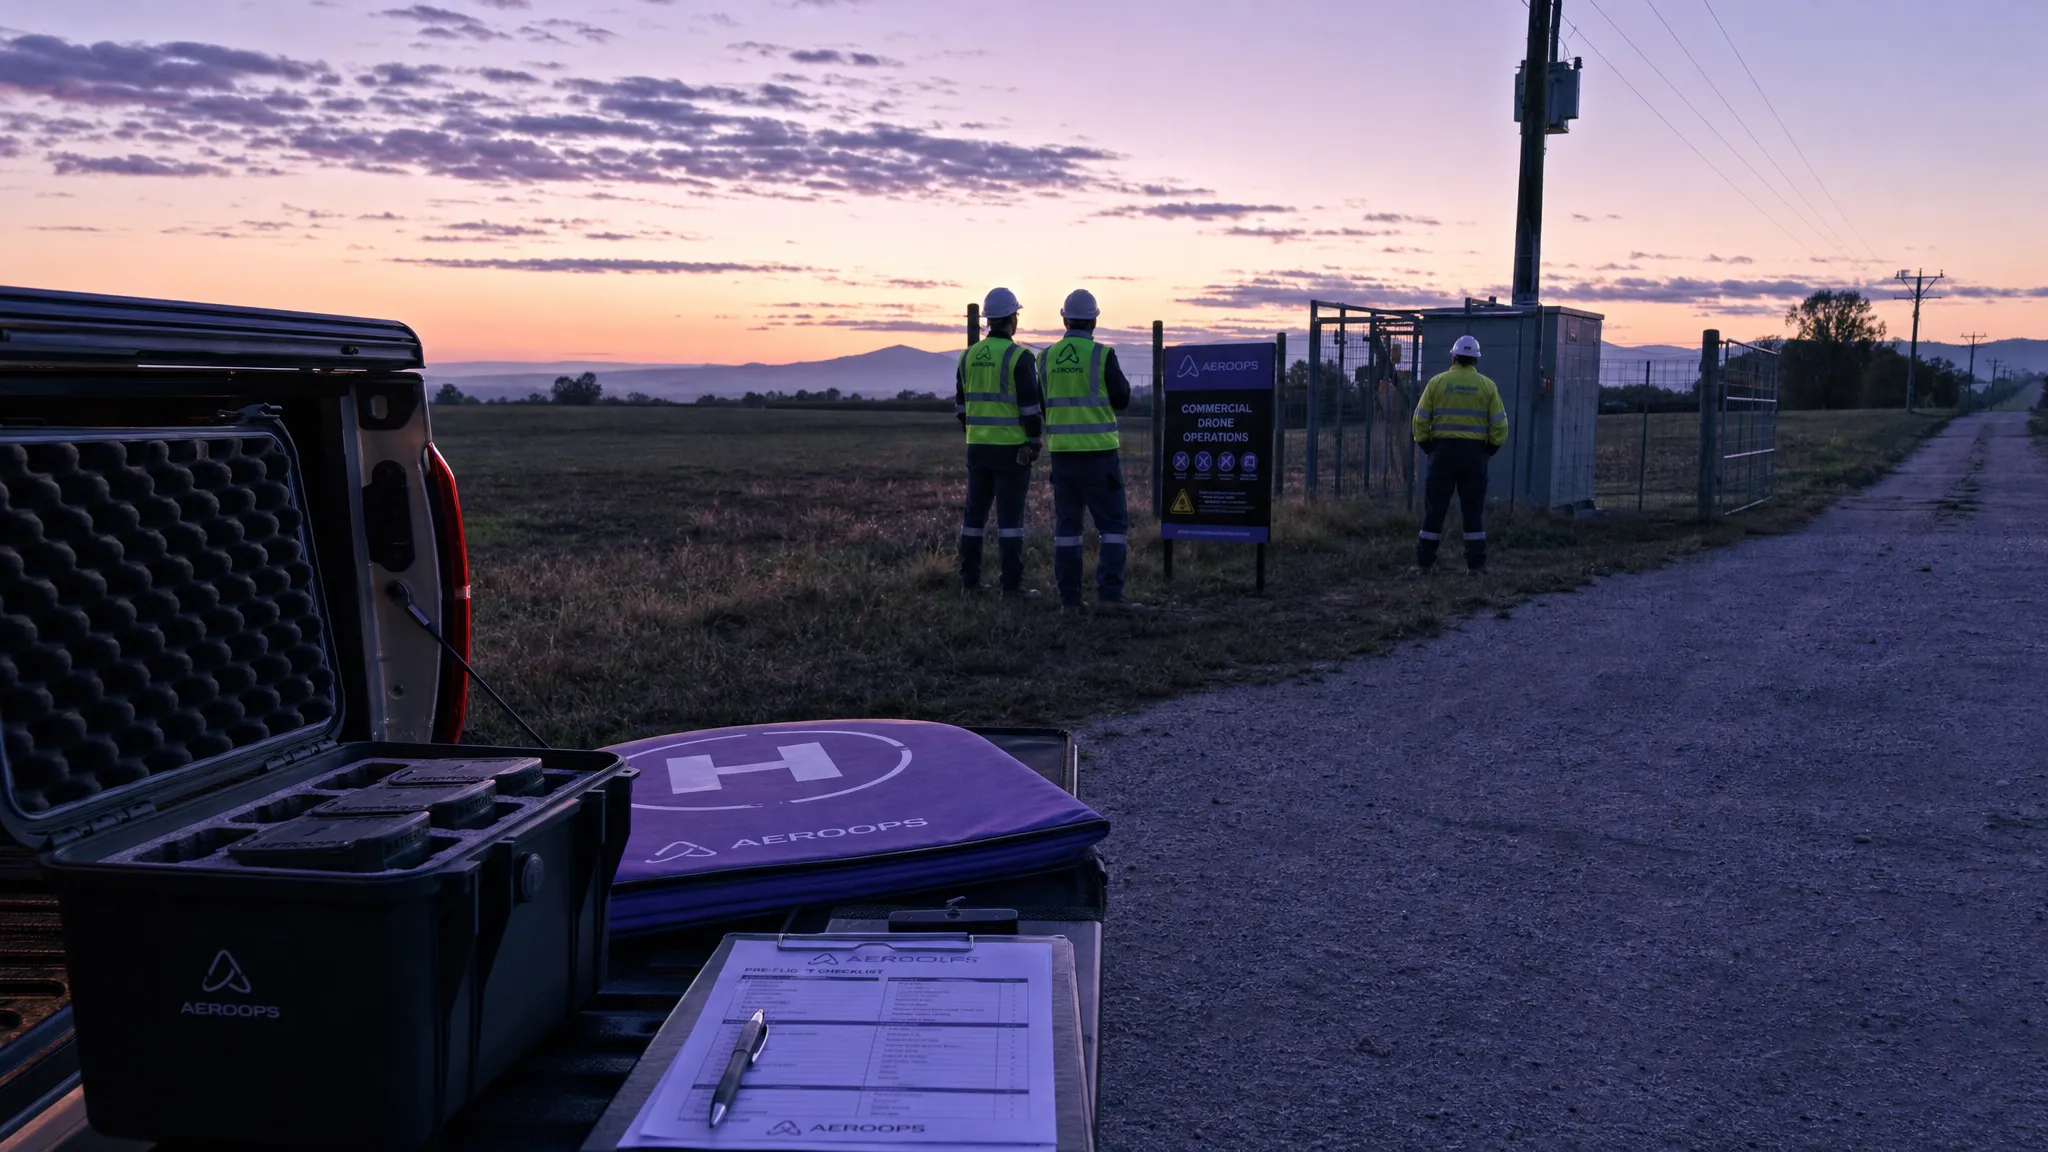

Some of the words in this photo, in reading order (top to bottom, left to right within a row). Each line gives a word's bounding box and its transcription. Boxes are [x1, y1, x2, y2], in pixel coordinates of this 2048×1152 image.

[1201, 360, 1259, 372] AEROOPS
[1181, 403, 1252, 414] COMMERCIAL
[1197, 417, 1235, 428] DRONE
[1182, 432, 1249, 443] OPERATIONS
[731, 817, 929, 849] AEROOPS
[180, 1001, 280, 1019] AEROOPS
[809, 1123, 926, 1134] AEROOPS
